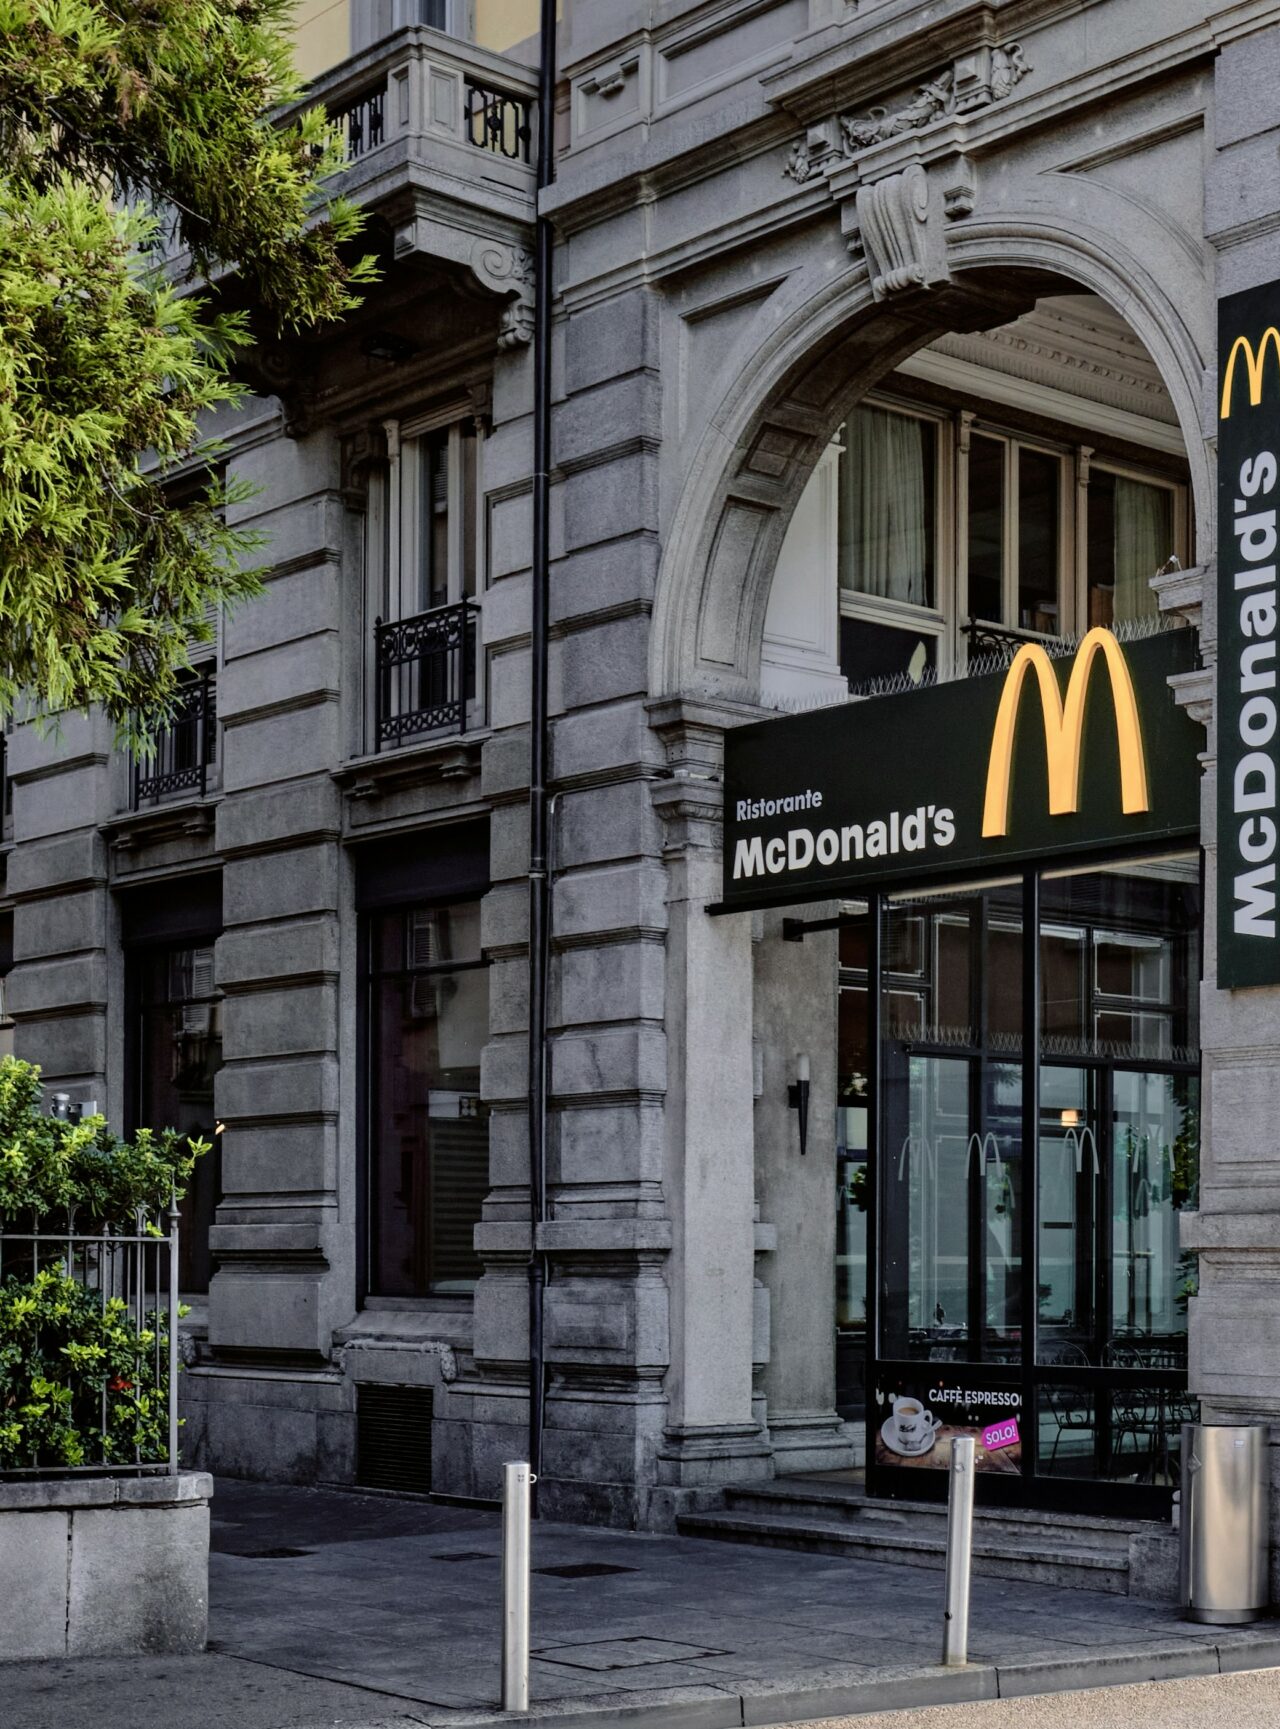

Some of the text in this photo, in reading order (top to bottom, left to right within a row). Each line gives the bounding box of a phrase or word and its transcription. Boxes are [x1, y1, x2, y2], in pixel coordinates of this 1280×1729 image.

[1234, 451, 1278, 938] McDonald's
[736, 789, 823, 822] Ristorante
[732, 804, 956, 880] McDonald's
[928, 1385, 963, 1403] CAFFÈ
[985, 1424, 1016, 1445] SOLO!
